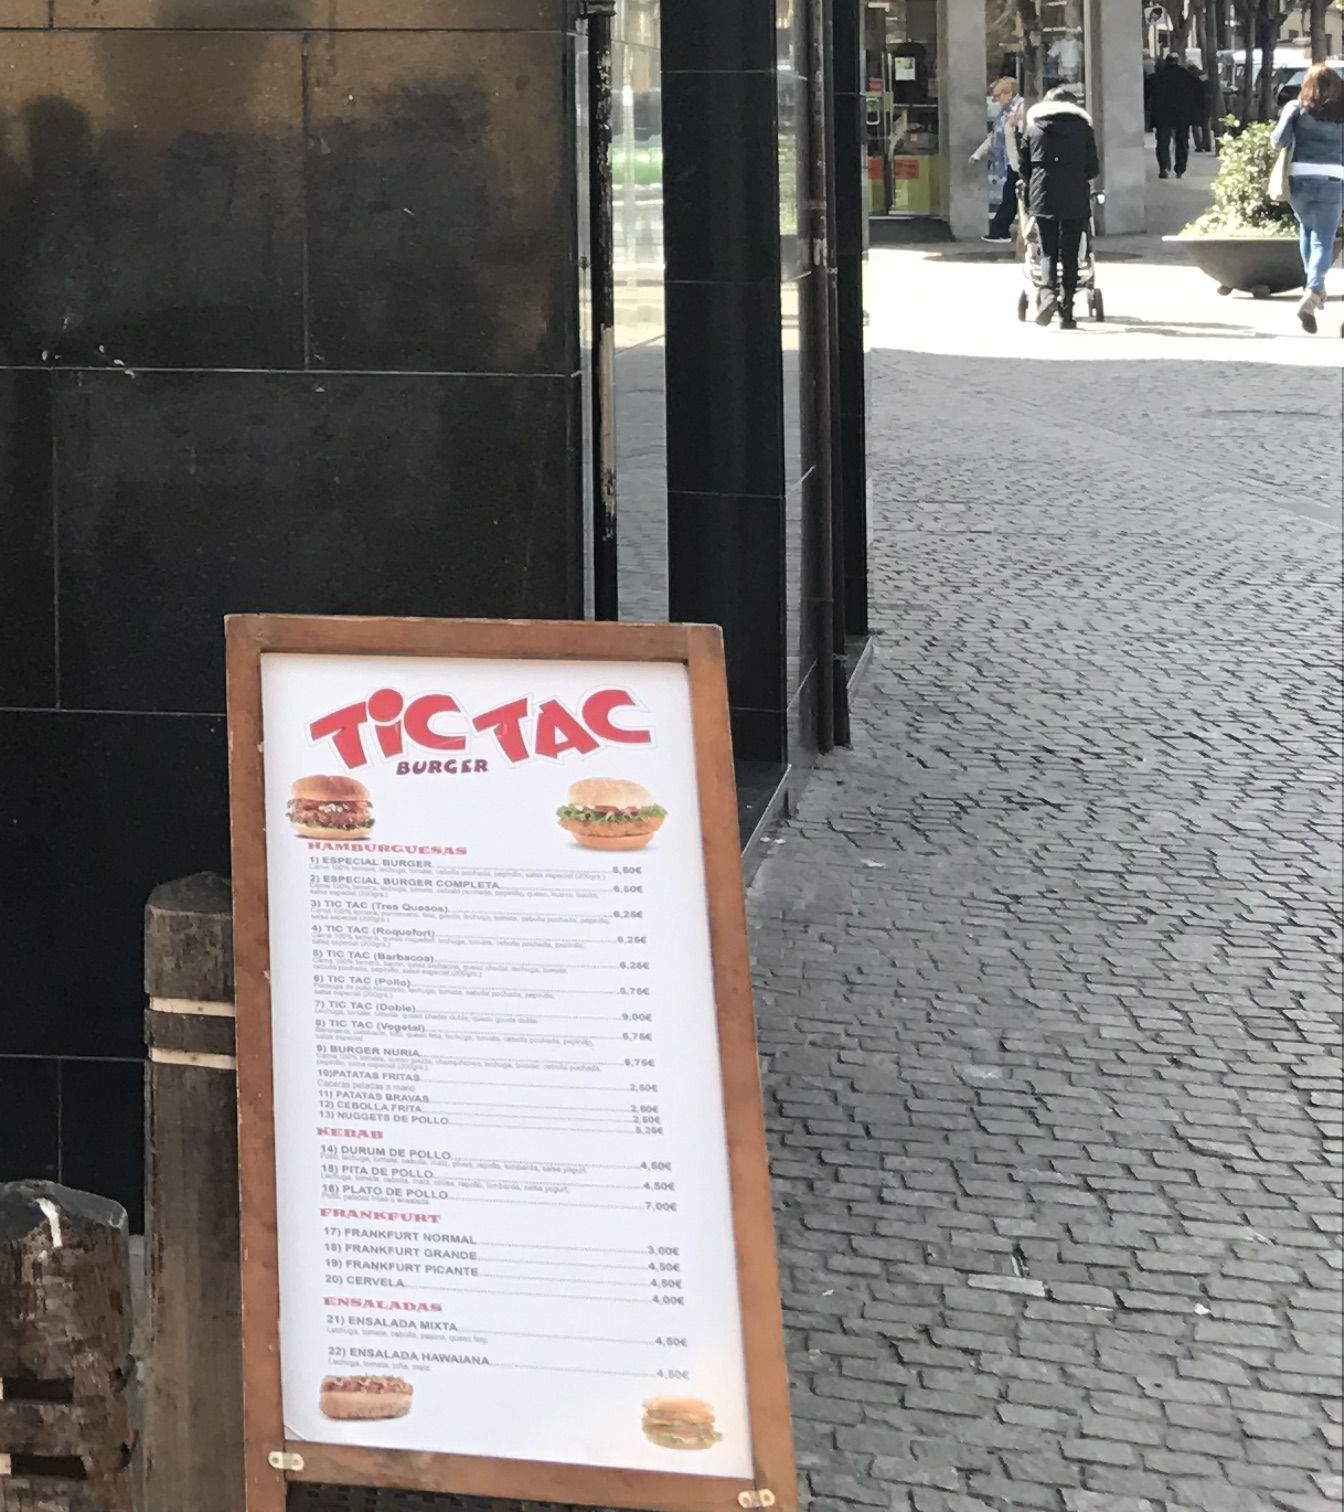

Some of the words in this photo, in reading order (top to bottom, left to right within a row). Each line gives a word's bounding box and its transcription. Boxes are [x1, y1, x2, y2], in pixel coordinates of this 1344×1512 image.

[473, 689, 651, 763] TAC
[396, 759, 489, 775] BURGER
[308, 842, 467, 855] HAMBURGUESAS
[322, 857, 378, 866] ESPECIAL
[383, 859, 431, 867] BURGER
[323, 876, 380, 884] ESPECIAL
[384, 878, 432, 886] BURGER
[436, 879, 500, 889] COMPLETA
[325, 900, 342, 908] TIC
[348, 926, 369, 934] TAC
[327, 950, 344, 958] TIC
[330, 1045, 380, 1055] BURGER
[383, 1073, 420, 1081] FRITAS
[336, 1091, 382, 1100] PATATAS
[386, 1093, 429, 1103] BRAVAS
[337, 1101, 388, 1110] CEBOLLA
[392, 1104, 422, 1113] FRITA
[337, 1112, 390, 1121] NUGGETS
[412, 1116, 449, 1125] POLLO
[316, 1127, 383, 1138] KEBAB
[341, 1146, 385, 1156] DURUM
[389, 1148, 405, 1156] DE
[410, 1150, 451, 1160] POLLO
[342, 1165, 367, 1174] PITA
[372, 1167, 387, 1175] DE
[392, 1168, 433, 1177] POLLO
[343, 1185, 382, 1195] PLATO
[386, 1188, 402, 1196] DE
[406, 1189, 448, 1199] POLLO
[320, 1208, 440, 1223] FRANKFURT
[345, 1228, 419, 1240] FRANKFURT
[423, 1233, 476, 1244] NORMAL
[345, 1244, 420, 1256] FRANKFURT
[424, 1248, 477, 1260] GRANDE
[346, 1260, 421, 1272] FRANKFURT
[425, 1265, 479, 1276] PICANTE
[347, 1276, 405, 1287] CERVELA
[323, 1297, 442, 1312] ENSALADAS
[348, 1316, 416, 1328] ENSALADA
[420, 1321, 457, 1331] MIXTA
[350, 1348, 418, 1360] ENSALADA
[422, 1353, 490, 1365] HAWAIANA
